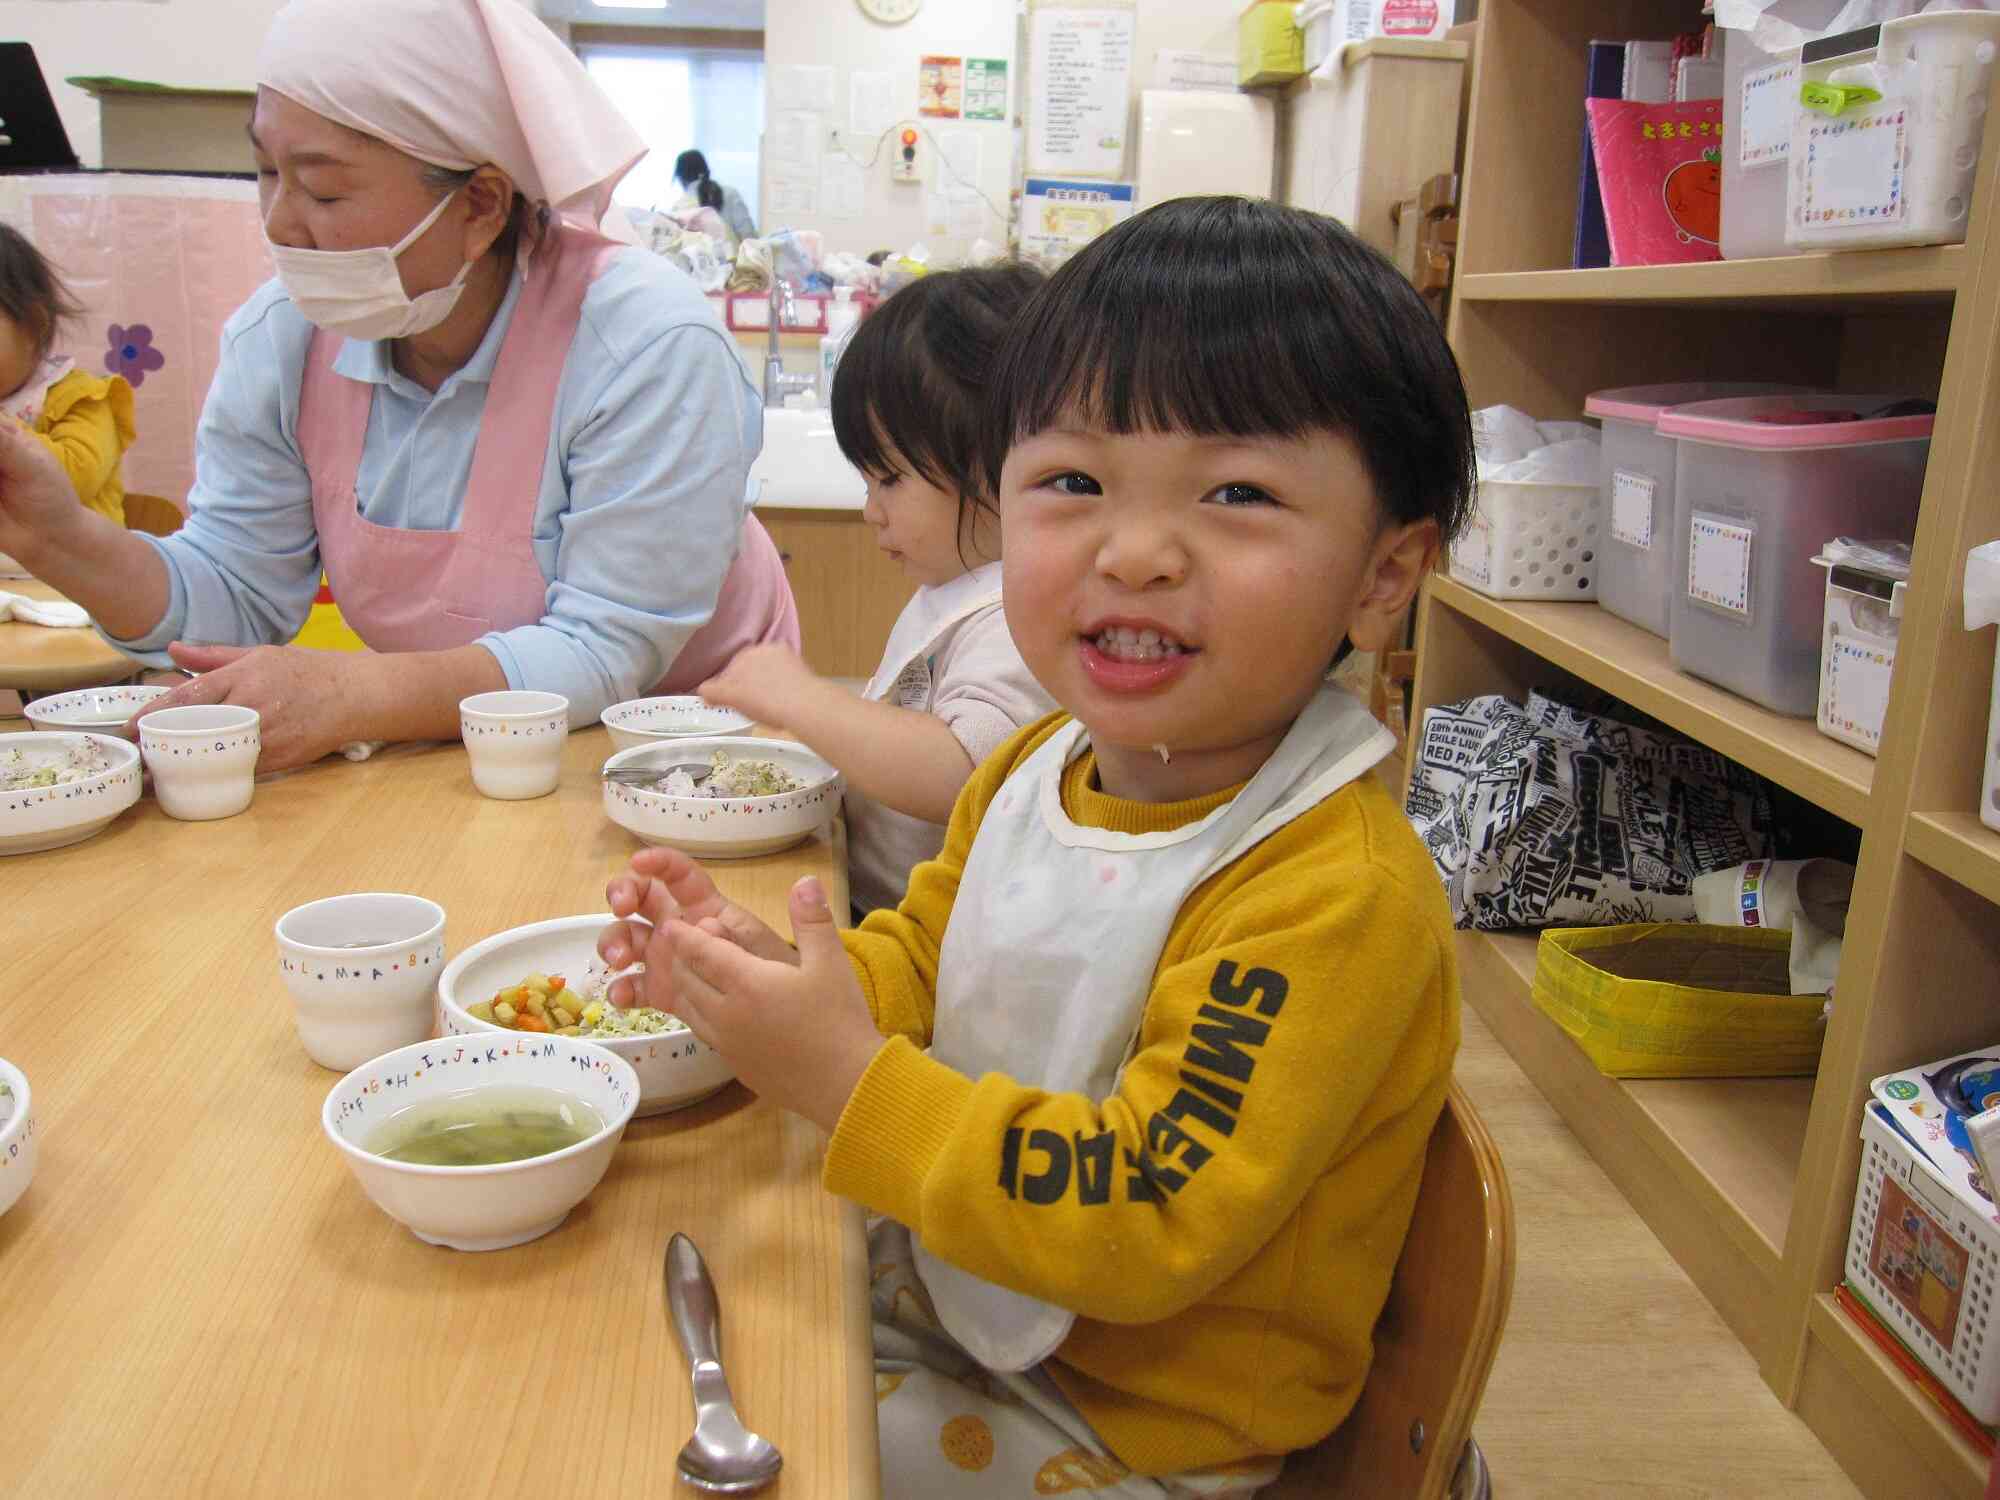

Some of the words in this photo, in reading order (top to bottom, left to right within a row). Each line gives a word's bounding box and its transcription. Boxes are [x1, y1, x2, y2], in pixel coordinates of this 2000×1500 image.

[215, 742, 226, 752] Q
[1426, 745, 1453, 761] RED
[22, 798, 32, 808] K
[722, 802, 729, 812] V
[743, 804, 753, 814] W
[769, 801, 777, 812] X
[301, 962, 308, 975] L
[336, 967, 348, 979] M
[372, 968, 383, 980] A
[408, 952, 417, 967] B
[685, 1043, 697, 1057] M
[397, 1074, 408, 1088] H
[421, 1054, 433, 1069] I
[453, 1049, 464, 1063] J
[486, 1048, 497, 1063] K
[517, 1040, 525, 1054] L
[543, 1043, 555, 1056] M
[580, 1056, 591, 1071] N
[601, 1063, 611, 1075] O
